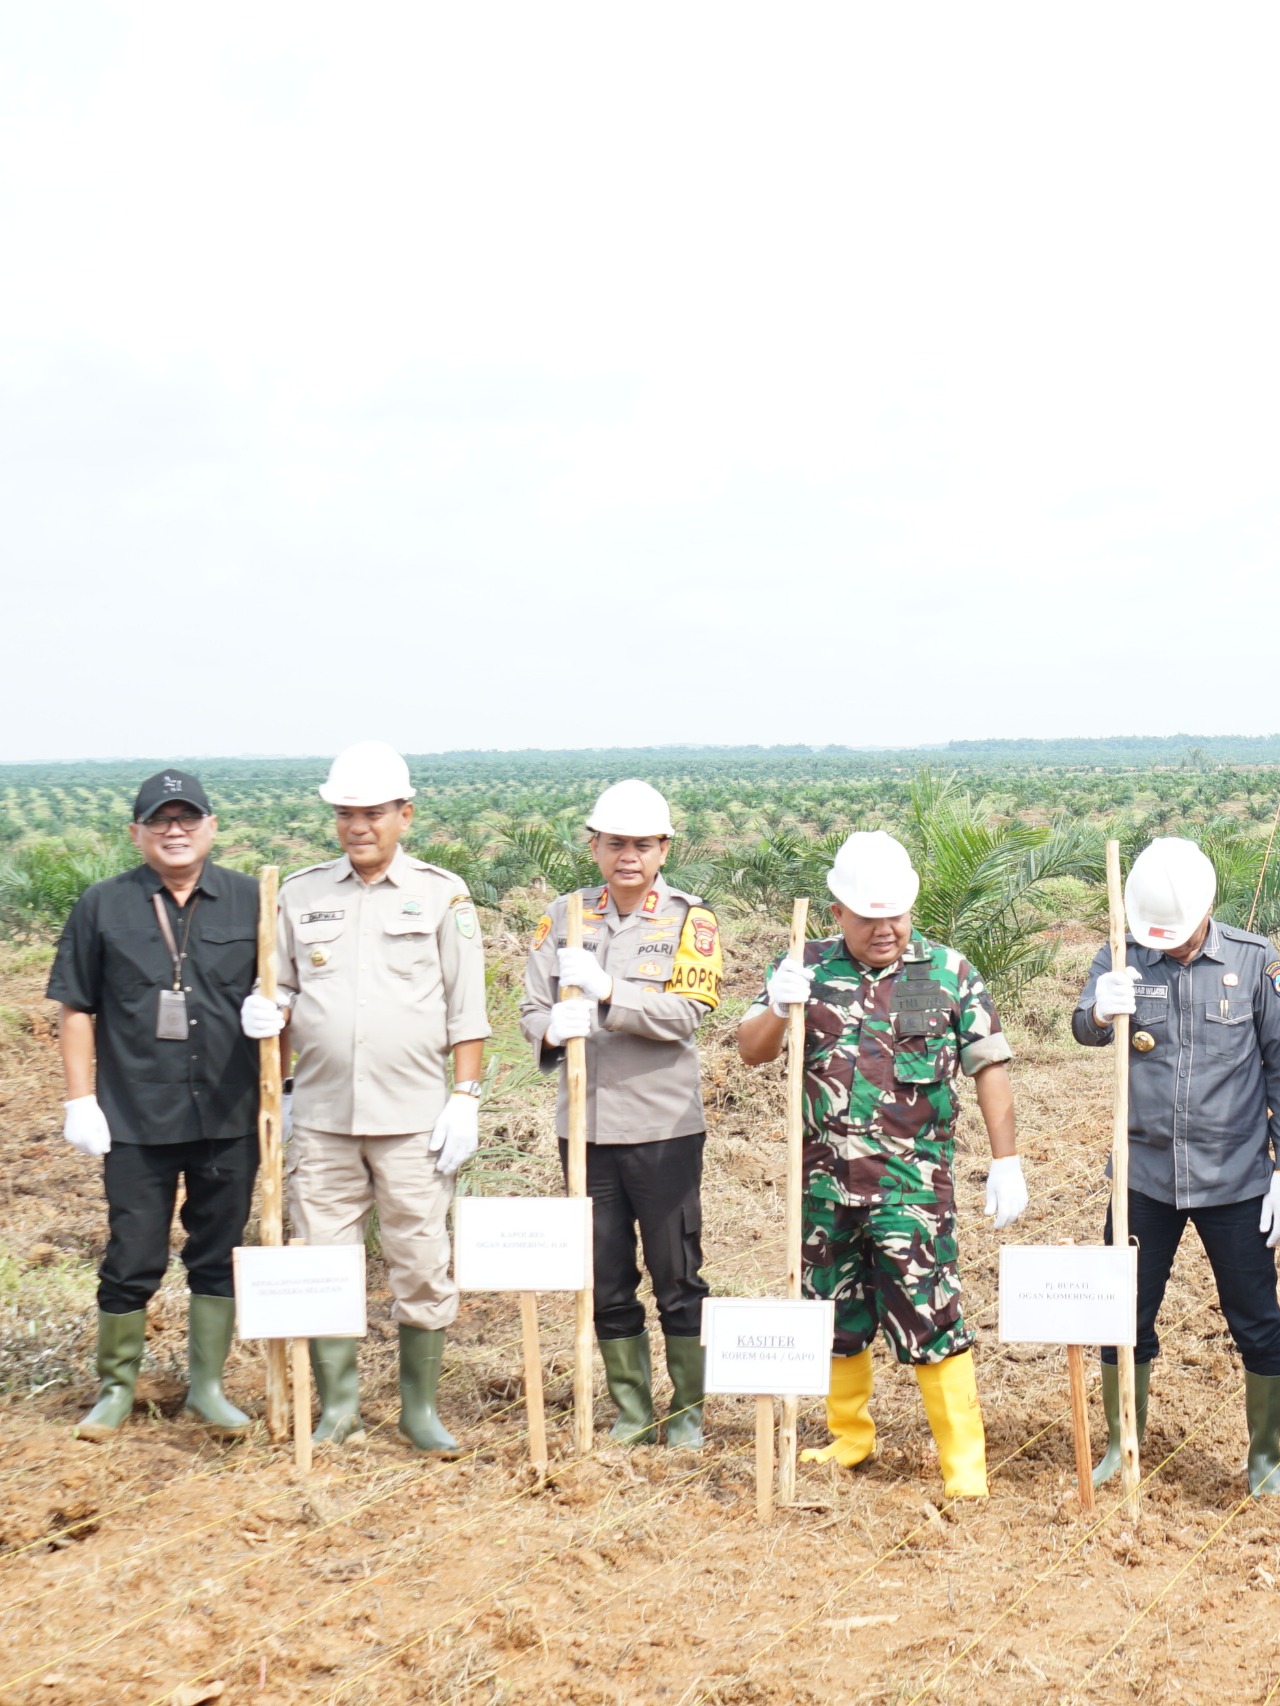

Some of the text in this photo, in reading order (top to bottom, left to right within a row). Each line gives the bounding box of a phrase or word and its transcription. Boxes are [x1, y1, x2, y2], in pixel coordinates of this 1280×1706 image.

[637, 943, 673, 956] POLRI
[687, 967, 712, 991] OPS
[899, 998, 918, 1009] TNI
[1046, 1293, 1095, 1301] KOMERING
[721, 1351, 757, 1360] KOREM
[759, 1351, 777, 1361] 044
[787, 1352, 815, 1362] GAPO
